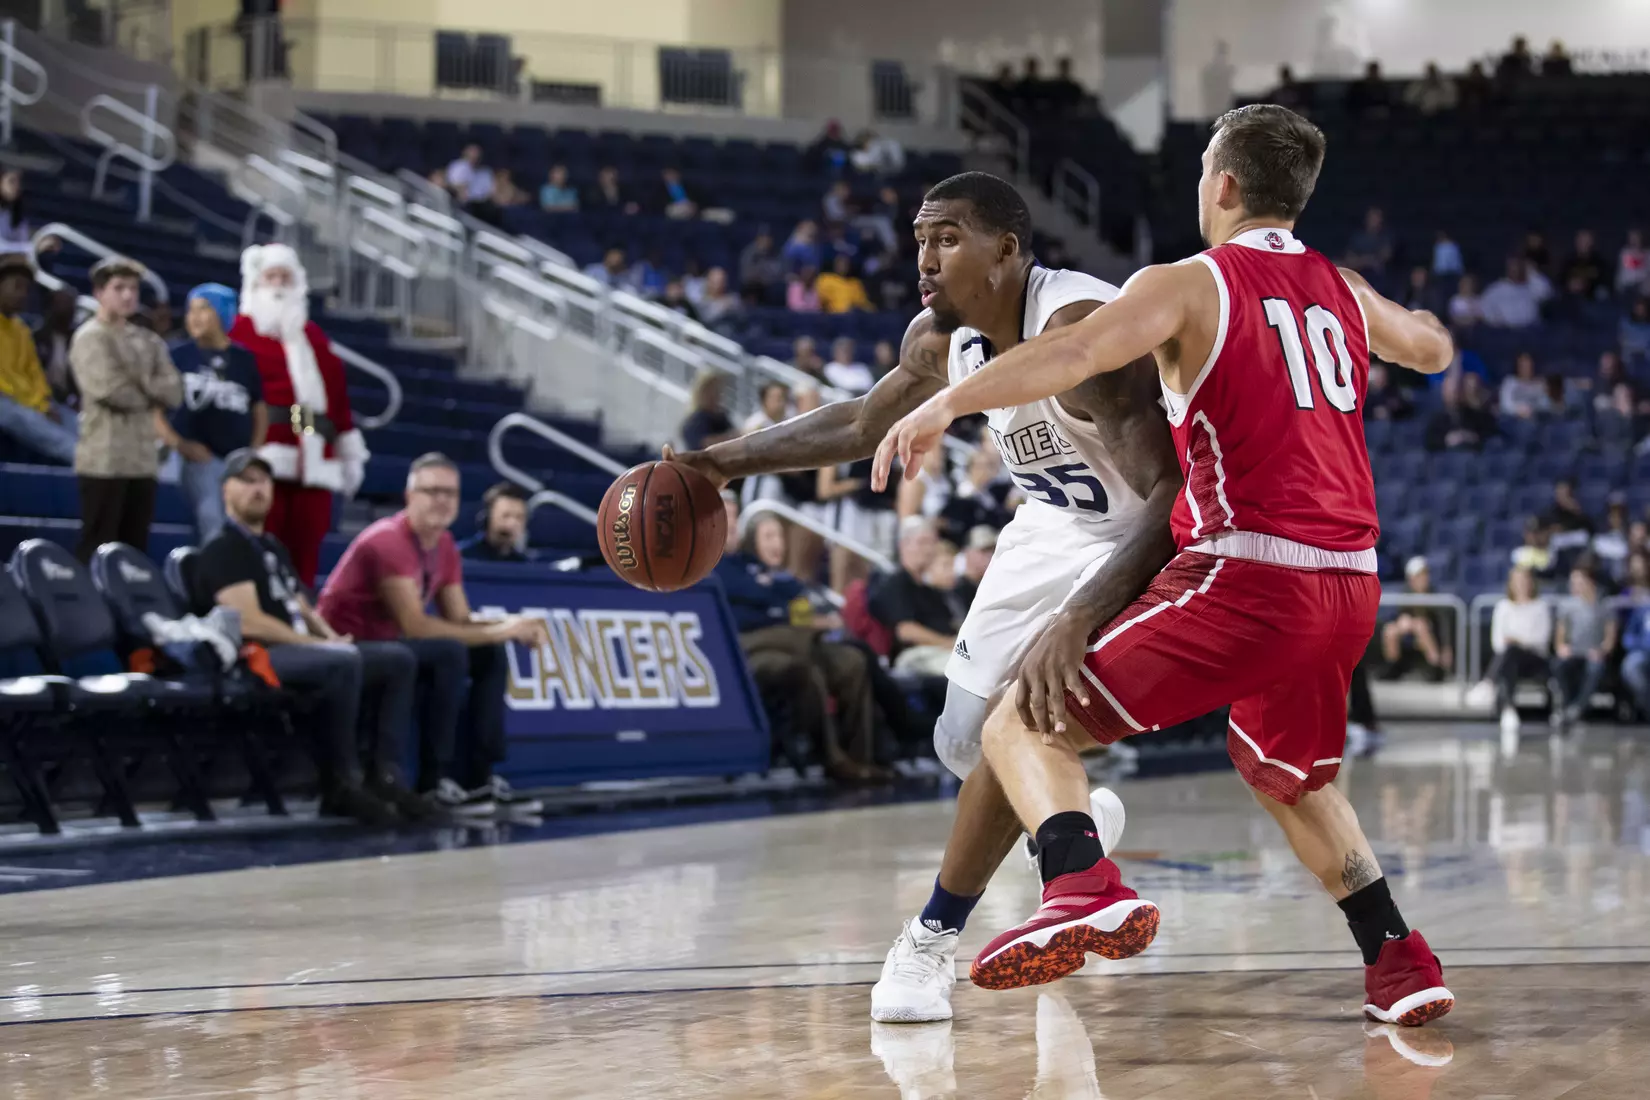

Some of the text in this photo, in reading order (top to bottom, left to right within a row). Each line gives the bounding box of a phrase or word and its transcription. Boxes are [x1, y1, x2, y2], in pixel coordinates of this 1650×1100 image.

[1259, 296, 1357, 414] 10
[612, 481, 639, 571] Wilson
[1011, 462, 1109, 514] 35
